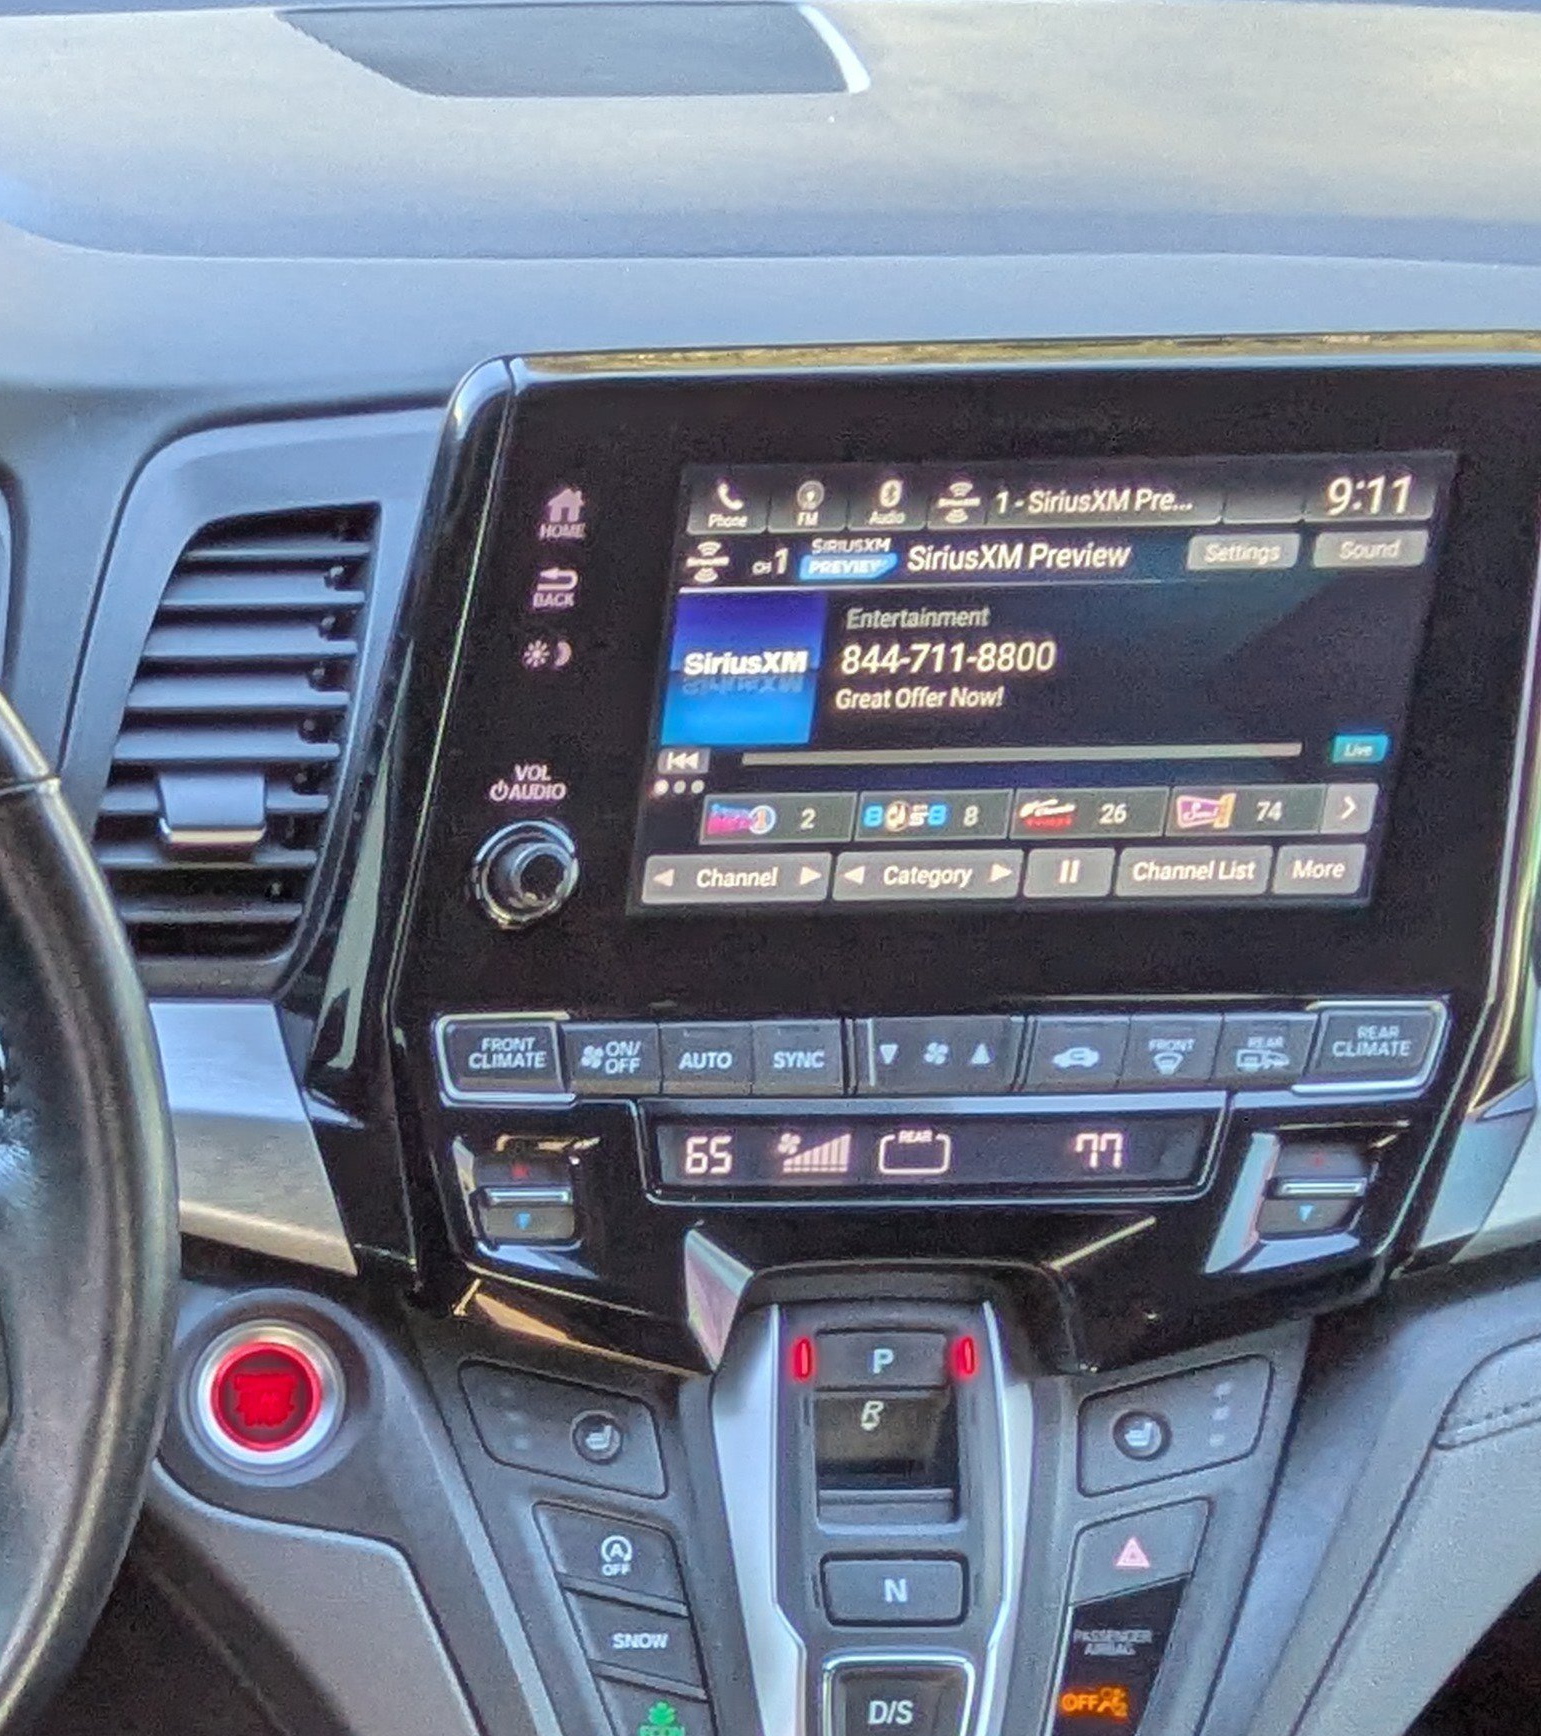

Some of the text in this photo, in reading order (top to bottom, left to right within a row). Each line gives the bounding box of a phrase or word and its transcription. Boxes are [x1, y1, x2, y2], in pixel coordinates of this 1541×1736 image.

[996, 492, 1010, 514] 1
[1028, 490, 1130, 514] SiriusXM
[1135, 488, 1194, 513] Pre...
[1327, 475, 1413, 517] 9:11
[707, 513, 748, 528] Phone
[796, 512, 819, 527] FM
[868, 511, 906, 526] Audio
[538, 522, 586, 541] HOME
[811, 537, 892, 554] SIRIUSXM
[1203, 542, 1281, 566] Settings
[1339, 539, 1400, 560] Sound
[774, 547, 788, 574] 1
[806, 557, 883, 575] PREVIEW
[907, 541, 1133, 571] SiriusXM Preview
[532, 591, 575, 609] BACK
[845, 607, 992, 630] Entertainment
[683, 650, 808, 676] SiriusXM
[840, 640, 1058, 676] 844-711-8800
[835, 686, 1005, 711] Great Offer Now!
[1343, 741, 1374, 758] Live
[514, 763, 552, 781] VOL
[508, 782, 568, 800] AUDIO
[800, 807, 817, 830] 2
[963, 804, 979, 828] 8
[1098, 803, 1127, 825] 26
[1256, 800, 1283, 822] 74
[696, 866, 779, 888] Channel
[883, 866, 973, 888] Category
[1132, 861, 1257, 882] Channel List
[1292, 860, 1346, 880] More
[1246, 1035, 1284, 1049] REAR
[1357, 1024, 1400, 1040] REAR
[480, 1037, 536, 1052] FRONT
[605, 1041, 642, 1057] ON/
[1148, 1037, 1196, 1054] FRONT
[1332, 1039, 1412, 1059] CLIMATE
[468, 1052, 547, 1071] CLIMATE
[605, 1057, 641, 1075] OFF
[678, 1052, 733, 1071] AUTO
[773, 1051, 825, 1070] SYNC
[897, 1129, 934, 1144] REAR
[684, 1135, 734, 1175] 65
[873, 1348, 895, 1375] P
[601, 1563, 632, 1577] OFF
[883, 1577, 908, 1603] N
[611, 1632, 669, 1650] SNOW
[1072, 1628, 1153, 1643] PASSENGER
[867, 1699, 914, 1725] D/S
[1061, 1692, 1098, 1712] OFF
